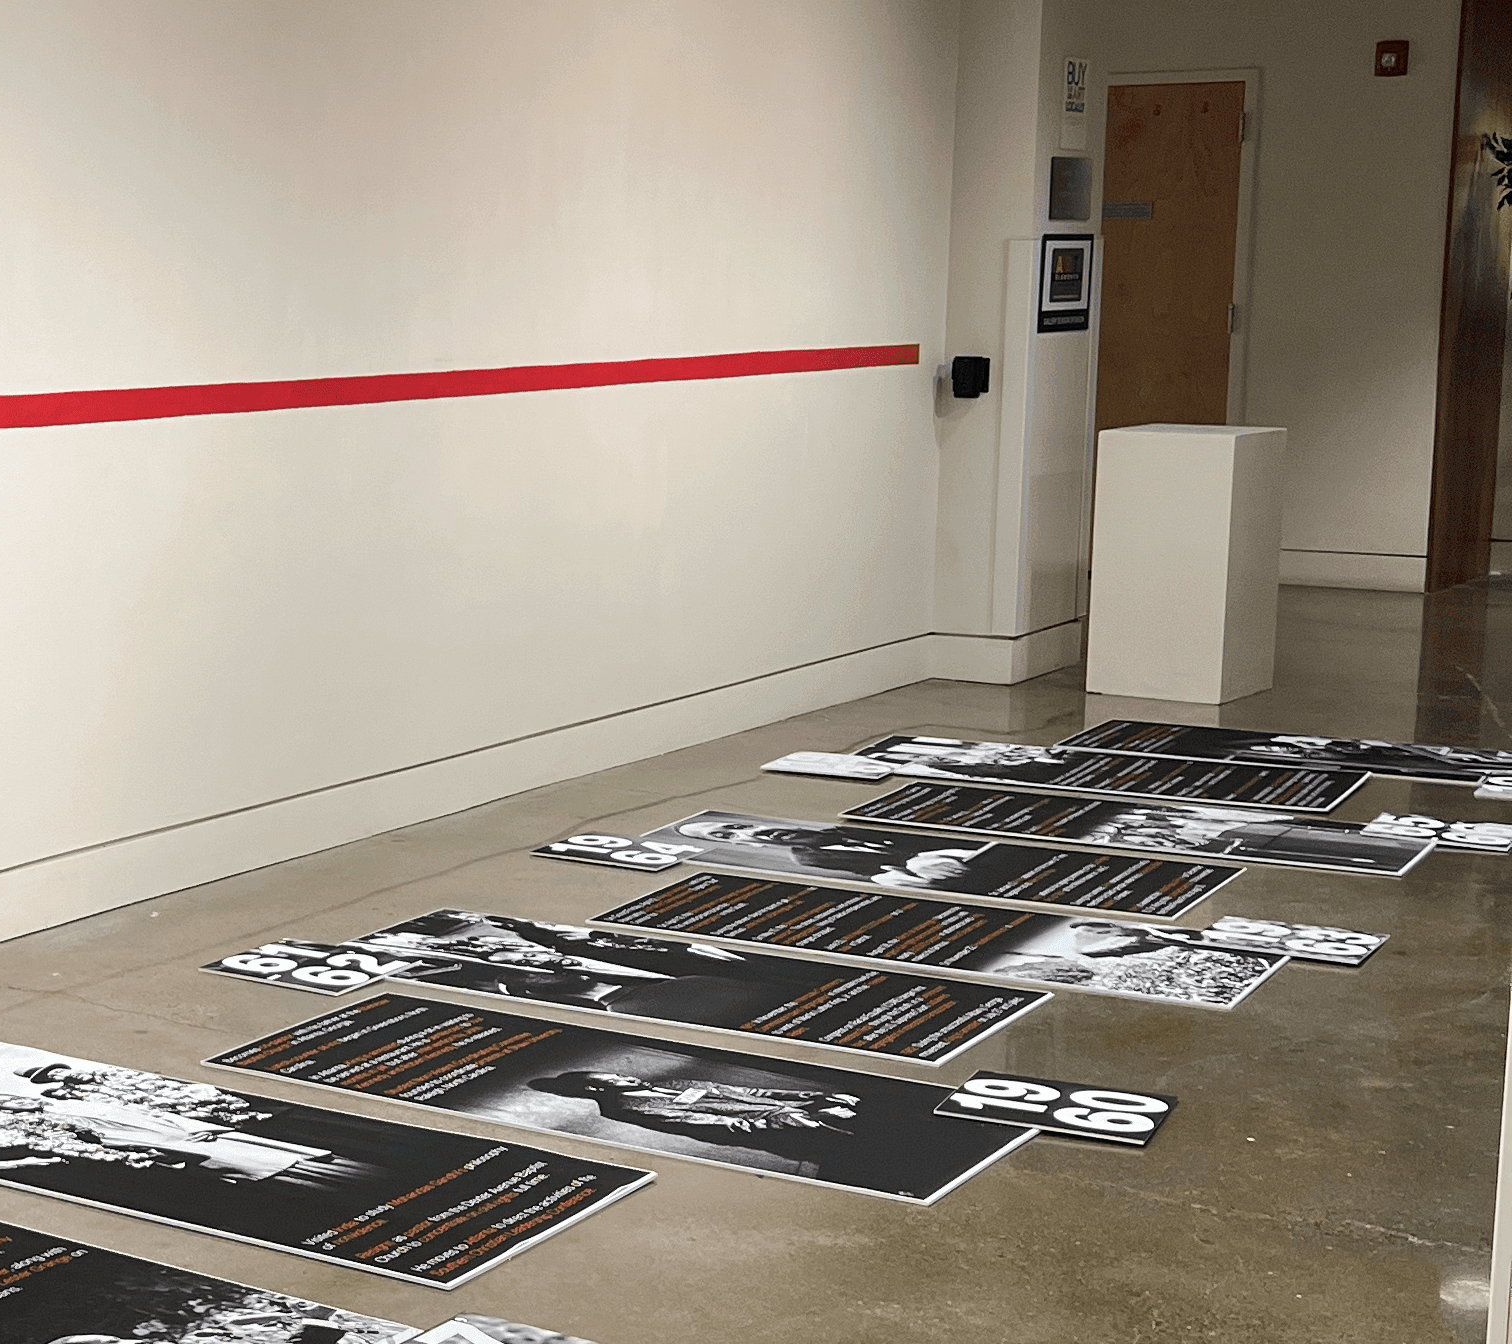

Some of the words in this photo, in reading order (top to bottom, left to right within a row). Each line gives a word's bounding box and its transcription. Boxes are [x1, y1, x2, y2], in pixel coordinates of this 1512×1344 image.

[1067, 61, 1088, 86] BUY
[549, 833, 633, 855] 19
[610, 840, 705, 865] 64
[1201, 920, 1292, 944] 19
[1284, 928, 1381, 956] 63
[949, 1077, 1062, 1114] 19
[1052, 1088, 1170, 1134] 60
